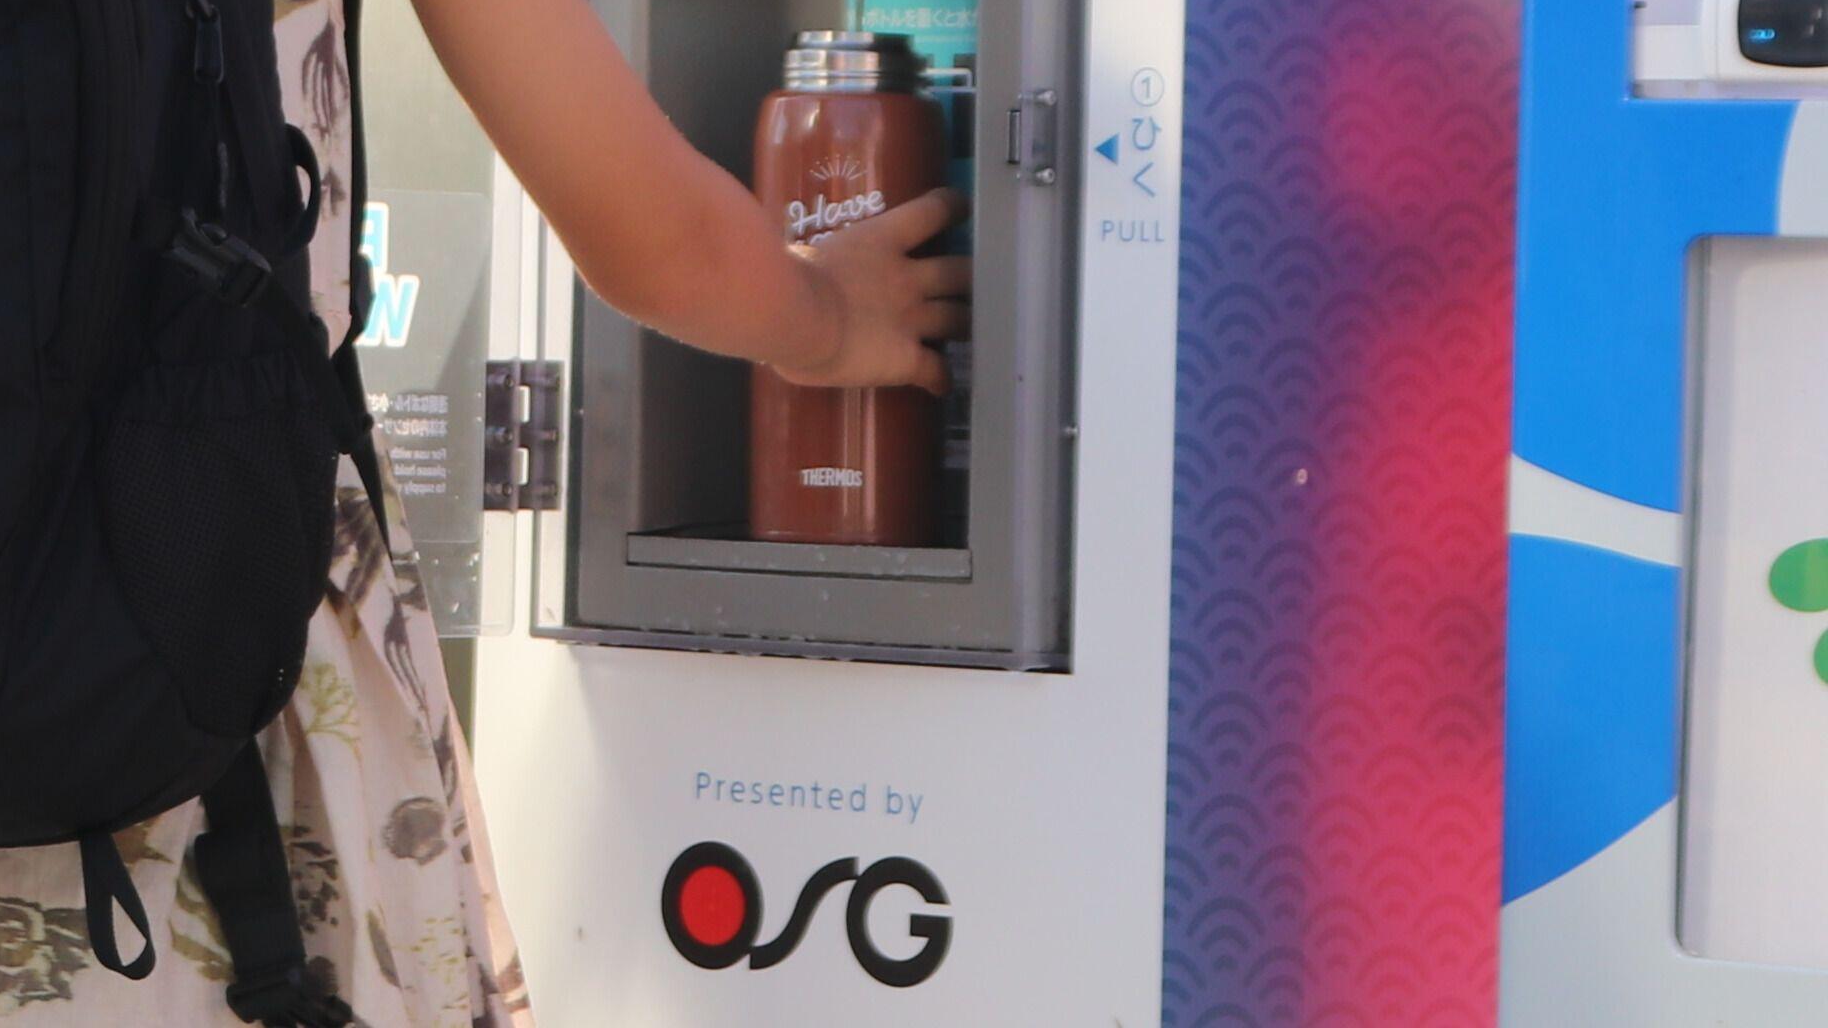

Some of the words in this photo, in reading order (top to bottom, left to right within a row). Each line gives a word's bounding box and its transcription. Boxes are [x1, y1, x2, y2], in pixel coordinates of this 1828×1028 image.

[788, 190, 887, 237] Have
[1101, 219, 1165, 243] PULL
[800, 466, 863, 487] THERMOS
[695, 771, 868, 813] Presented
[885, 785, 924, 824] by
[661, 840, 955, 989] OSG
